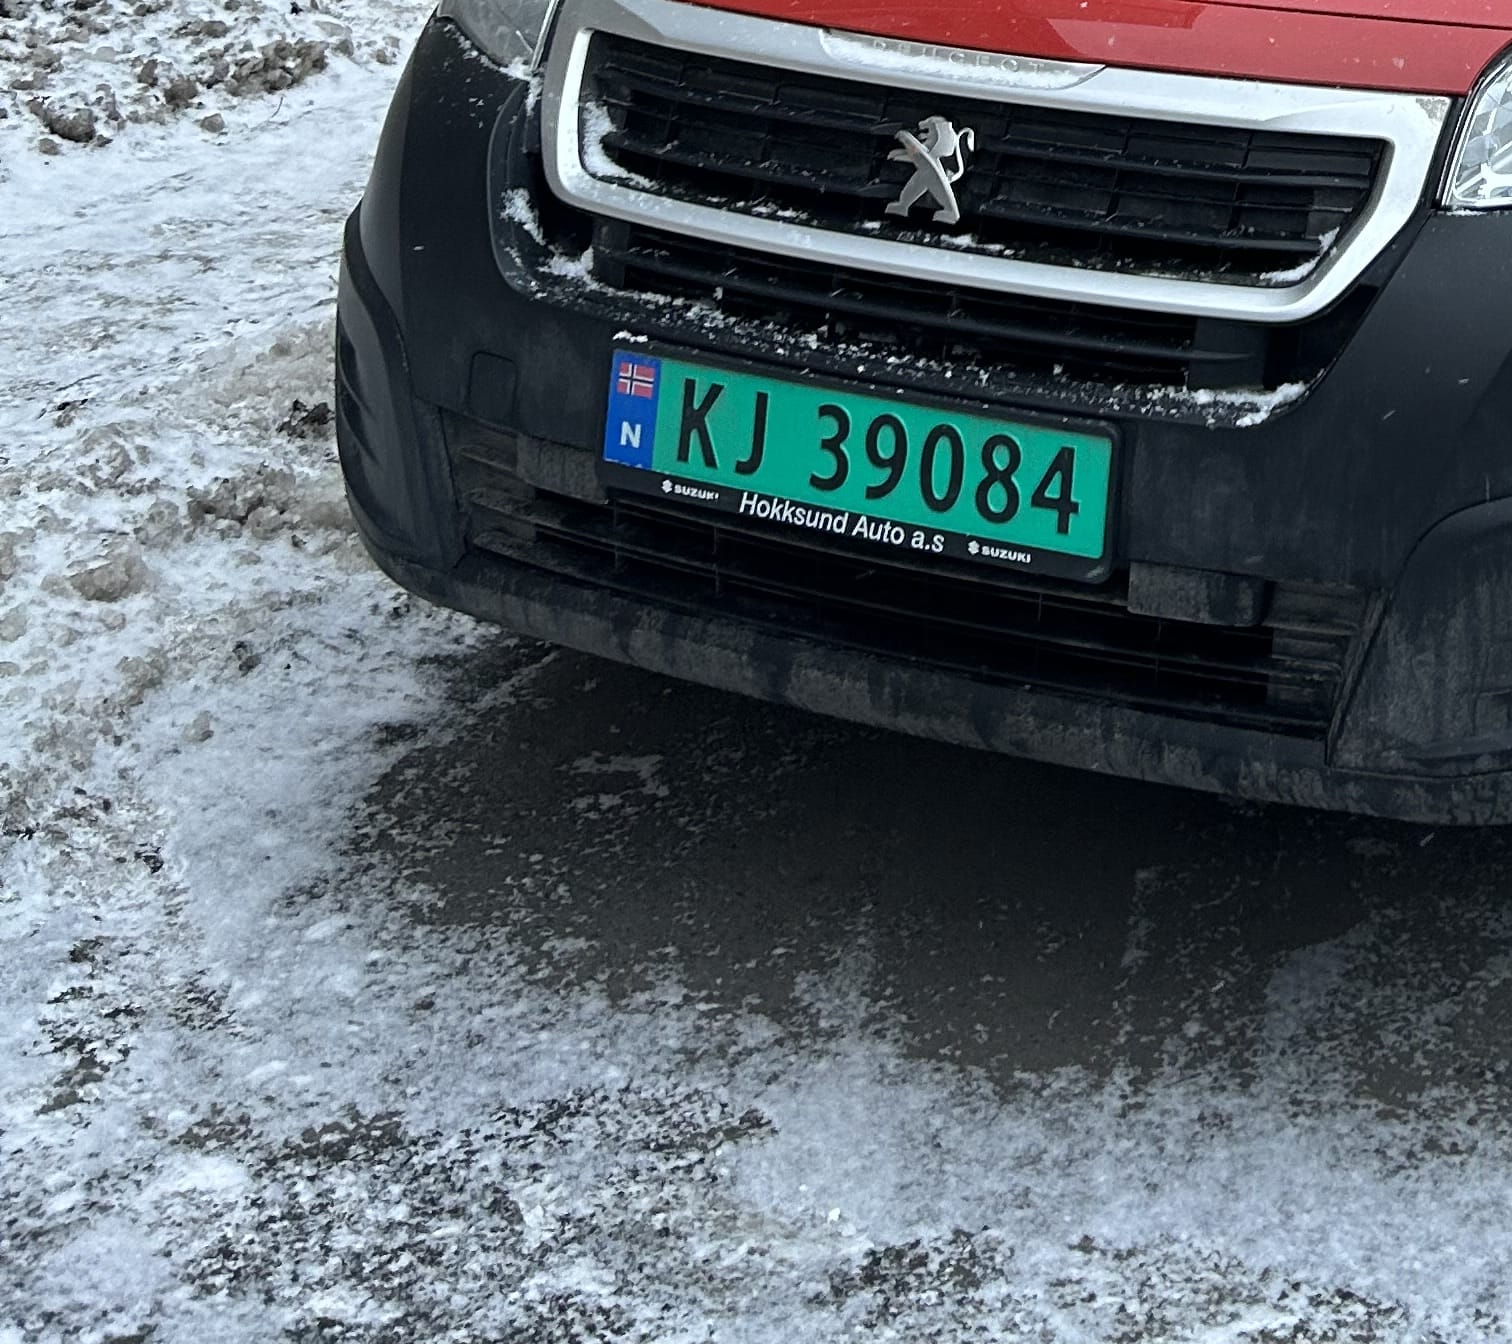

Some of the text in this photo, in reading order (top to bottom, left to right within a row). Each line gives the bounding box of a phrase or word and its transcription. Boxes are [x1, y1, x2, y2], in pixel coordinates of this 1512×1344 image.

[619, 421, 642, 449] N
[676, 377, 1080, 535] KJ 39084
[674, 484, 719, 500] SUZUKI
[739, 491, 945, 553] Hokksund Auto a.s
[981, 545, 1031, 563] SUZUKI
